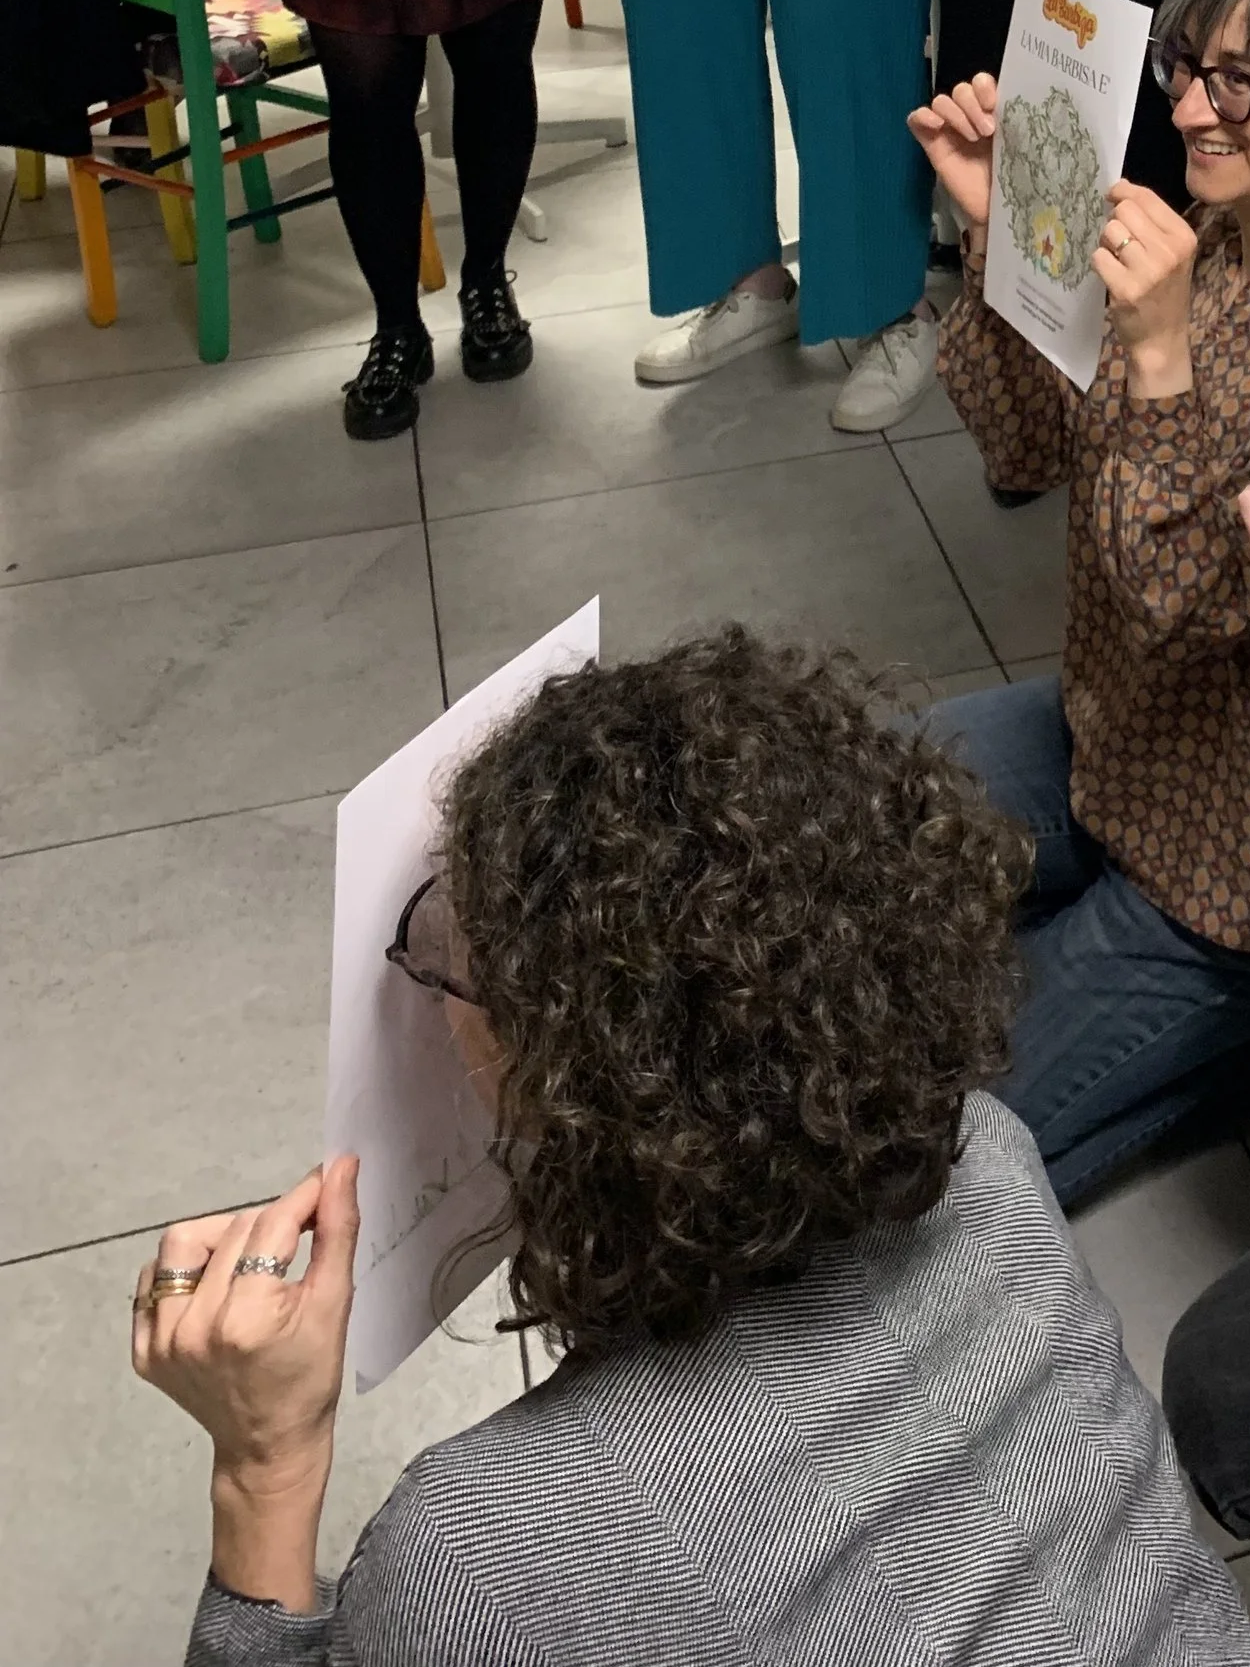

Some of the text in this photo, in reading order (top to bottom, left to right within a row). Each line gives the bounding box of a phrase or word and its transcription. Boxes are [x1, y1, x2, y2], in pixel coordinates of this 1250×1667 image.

[1020, 30, 1031, 52] LA
[1034, 36, 1050, 63] MIA
[1050, 47, 1096, 90] BARBISA
